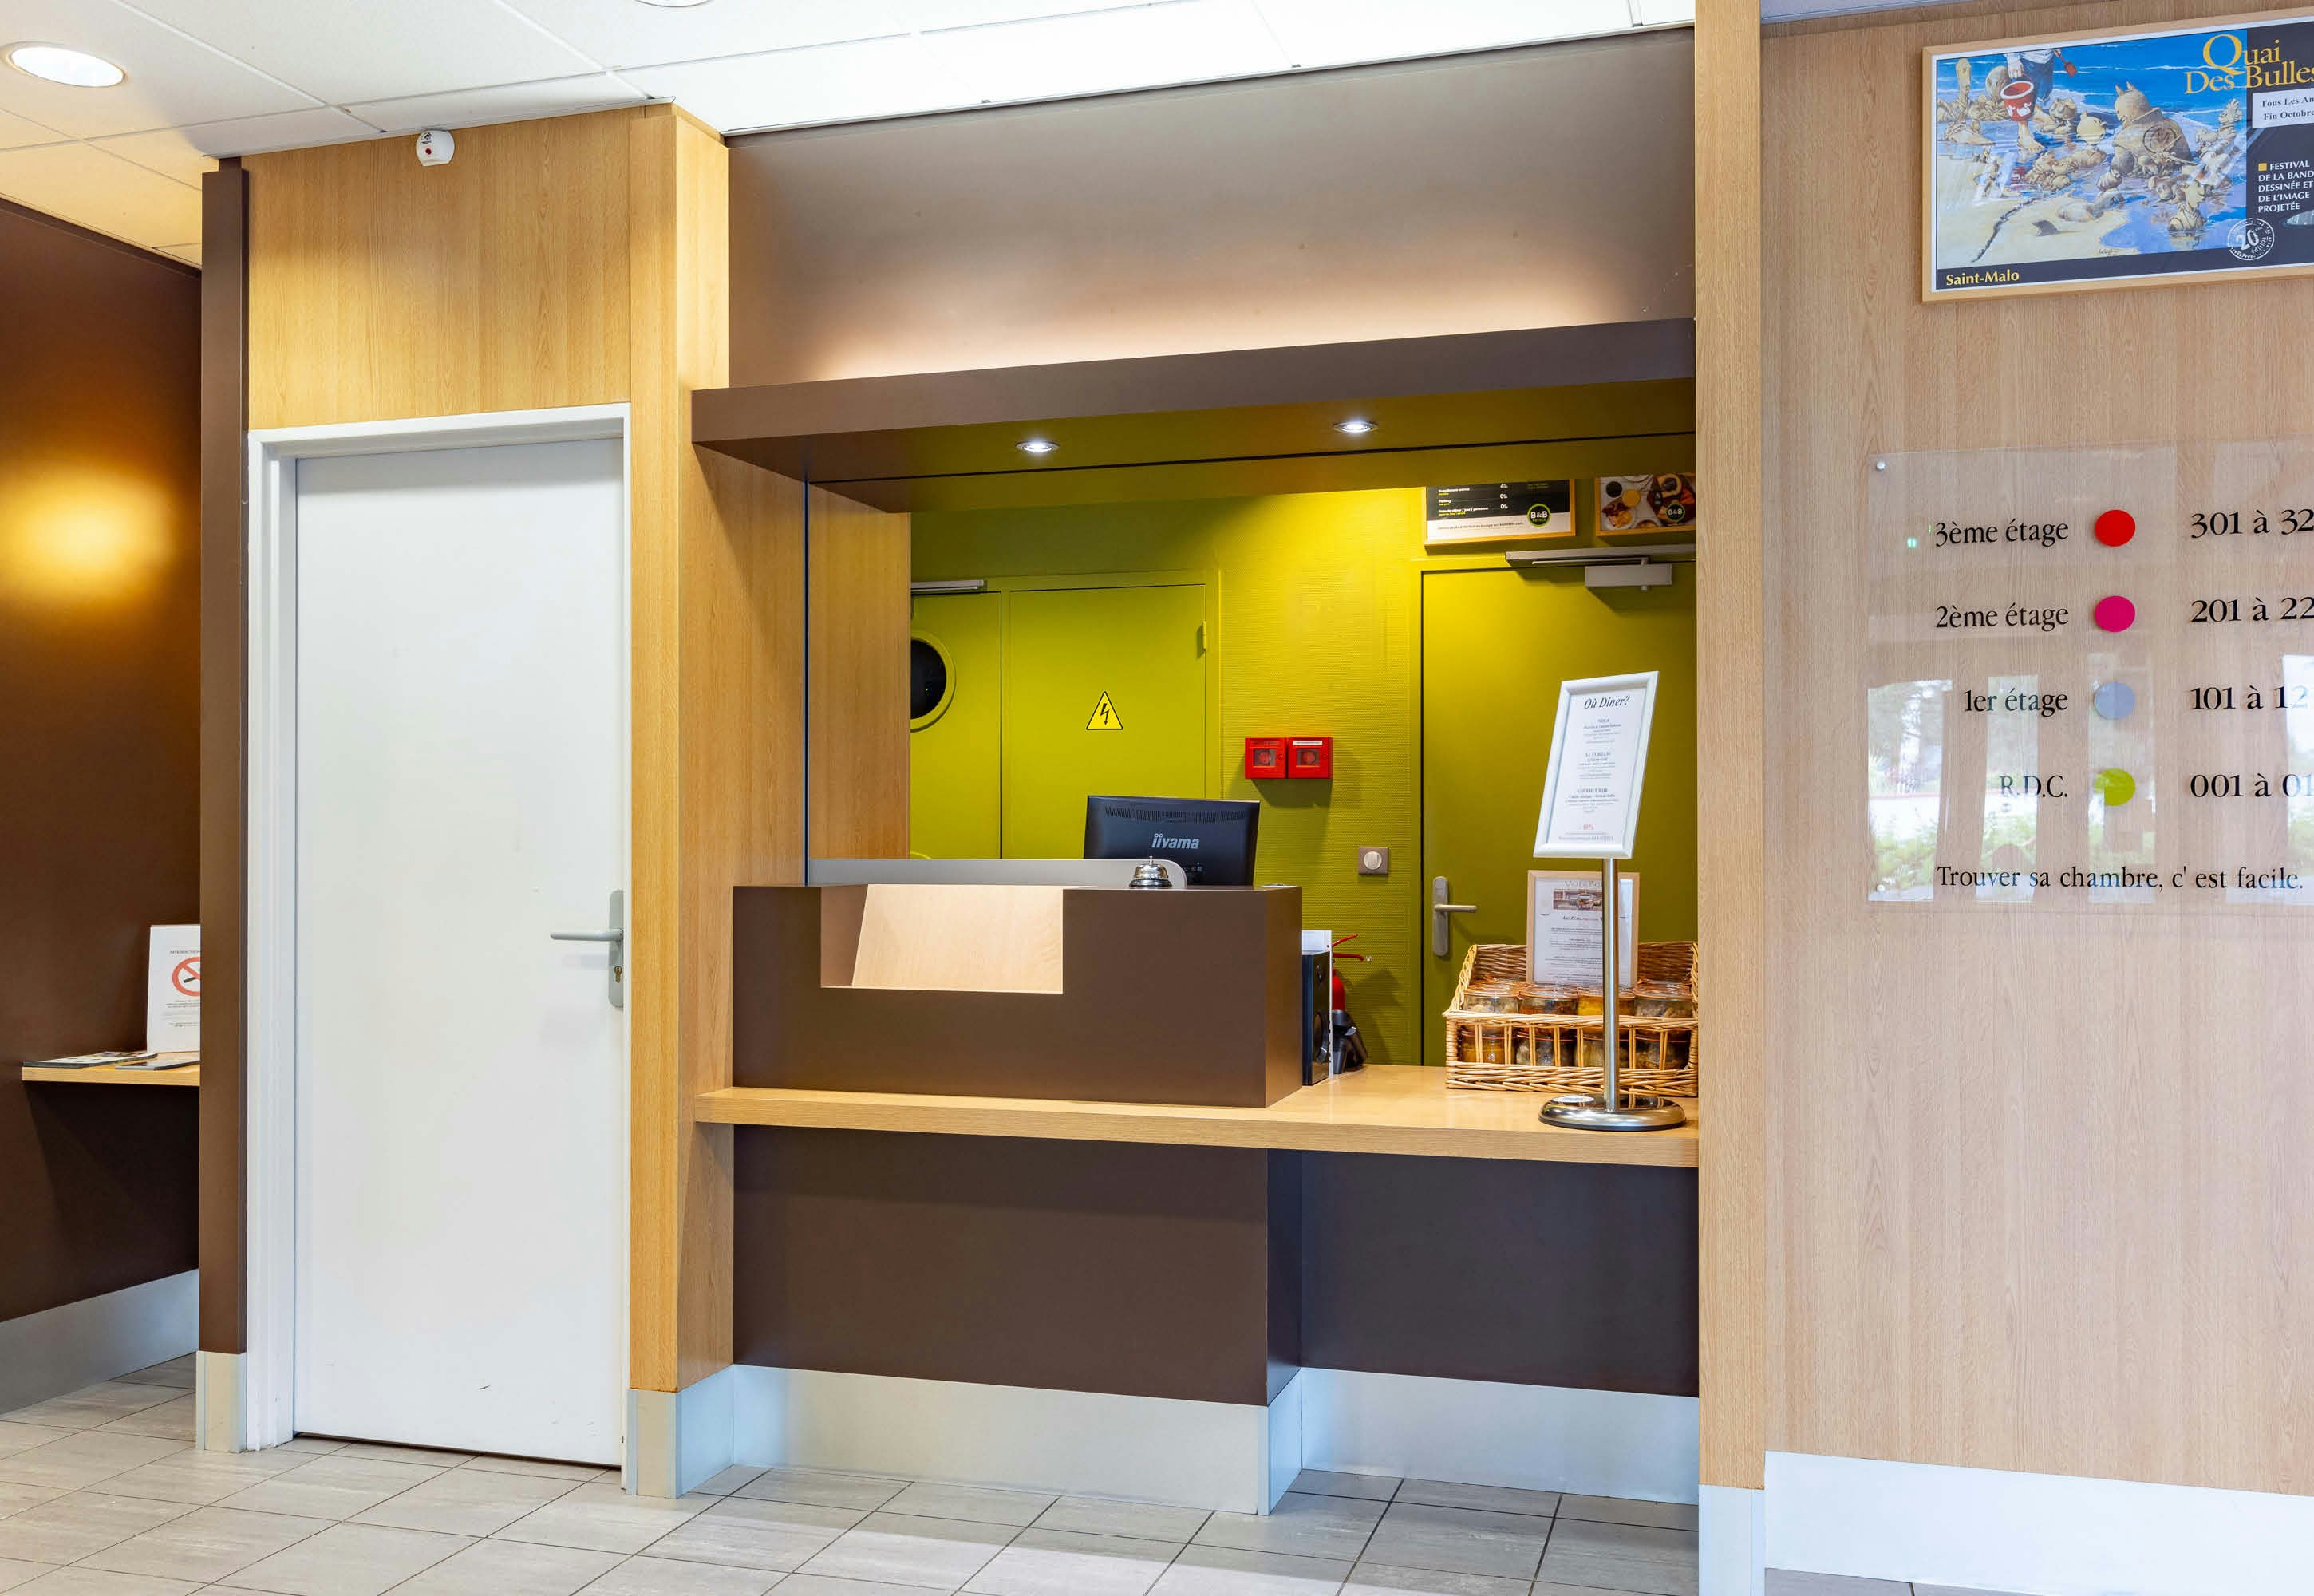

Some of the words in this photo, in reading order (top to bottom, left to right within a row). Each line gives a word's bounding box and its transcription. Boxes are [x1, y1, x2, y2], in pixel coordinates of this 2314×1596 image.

[2203, 34, 2282, 75] Quai
[2183, 70, 2235, 95] Des
[2261, 99, 2282, 108] Tous
[2284, 97, 2300, 105] Les
[2269, 160, 2310, 171] FESTIVAL
[2273, 172, 2284, 181] LA
[2288, 170, 2314, 180] BAND
[2258, 180, 2300, 192] DESSINÉE
[2273, 192, 2310, 202] L'IMAGE
[2258, 201, 2300, 213] PROJETÉE
[1945, 268, 2020, 286] Saint-Malo
[1530, 511, 1548, 519] B&B
[1935, 520, 1998, 547] 3ème
[2005, 519, 2069, 547] étage
[2191, 512, 2243, 539] 301
[2253, 509, 2270, 534] à
[1936, 604, 1998, 628] 2ème
[2005, 602, 2069, 632] étage
[2190, 598, 2242, 622] 201
[2253, 597, 2269, 622] à
[1964, 689, 1998, 712] 1er
[2004, 687, 2068, 717] étage
[2190, 686, 2237, 710] 101
[2247, 685, 2264, 709] à
[1999, 775, 2068, 798] R.D.C.
[2190, 774, 2244, 798] 001
[2254, 772, 2272, 797] à
[1151, 833, 1200, 850] iiyama
[1937, 866, 2021, 887] Trouver
[2029, 871, 2051, 887] sa
[2059, 865, 2163, 893] chambre,
[2195, 871, 2227, 889] est
[2237, 867, 2304, 889] facile.
